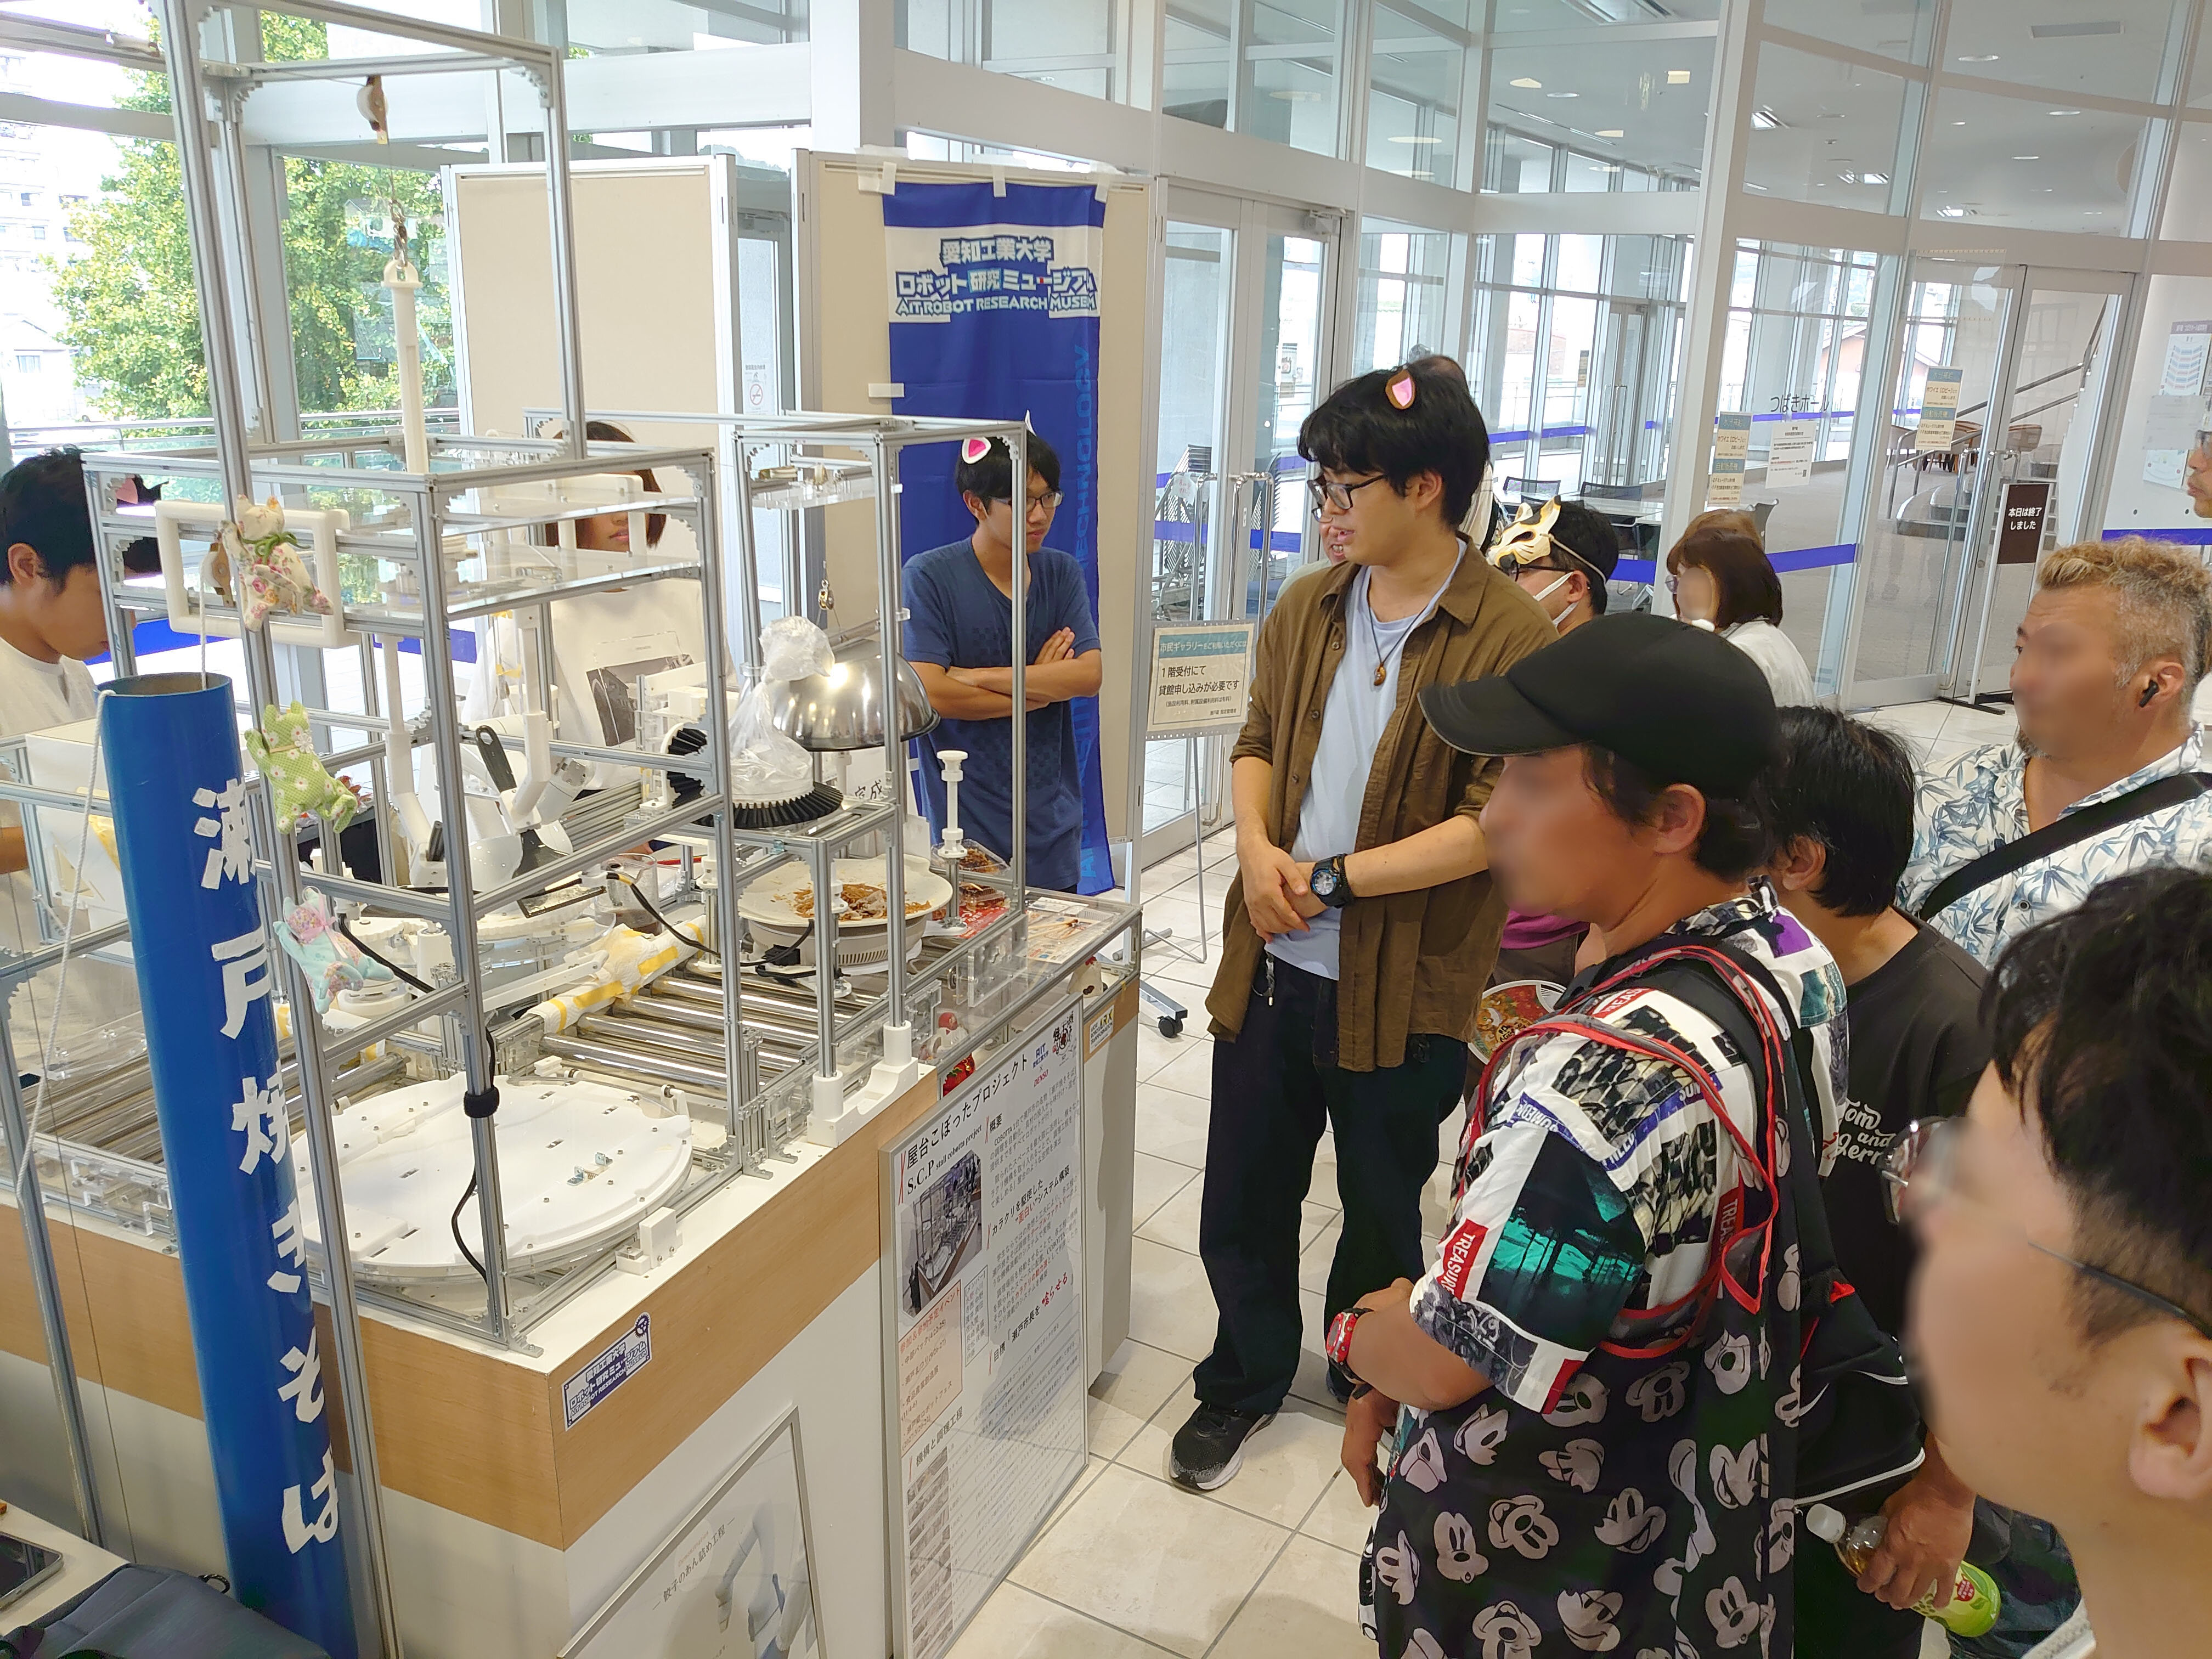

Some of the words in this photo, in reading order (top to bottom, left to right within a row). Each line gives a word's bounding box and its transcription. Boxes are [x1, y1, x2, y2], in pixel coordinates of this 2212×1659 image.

[943, 238, 1053, 265] 愛知工業大学
[896, 300, 922, 315] AIT
[922, 299, 974, 315] ROBOT
[977, 296, 1048, 312] RESEARCH
[1770, 393, 1830, 414] つばきホール
[2008, 506, 2042, 518] 本日は終了
[2010, 520, 2036, 531] しました
[1158, 680, 1240, 696] 貸館申し込みが必要です
[1099, 1008, 1113, 1030] ARX
[1036, 1041, 1046, 1059] AIT
[1034, 1068, 1048, 1088] DENSO
[906, 1049, 1028, 1172] 屋台こぼったプロジェクト
[990, 1112, 1002, 1135] 概要
[1844, 1097, 1882, 1131] Tom
[1836, 1133, 1883, 1165] Jerr
[1857, 1128, 1897, 1148] and
[907, 1156, 934, 1197] S.C.P
[936, 1153, 946, 1171] stall
[947, 1137, 964, 1161] cobotta
[966, 1122, 981, 1147] project
[992, 1175, 1043, 1238] カラクリを駆使した
[586, 1342, 626, 1381] 愛知工業大学
[994, 1339, 1005, 1364] 目標
[569, 1341, 647, 1409] ロボット研究ミュージアム
[570, 1407, 580, 1419] AIT
[579, 1390, 599, 1410] ROBOT
[599, 1368, 626, 1396] RESEARCH
[625, 1348, 648, 1372] MUSEUM
[916, 1403, 962, 1470] 機構と調理工程
[662, 1524, 727, 1603] 餃子のあん詰め工程
